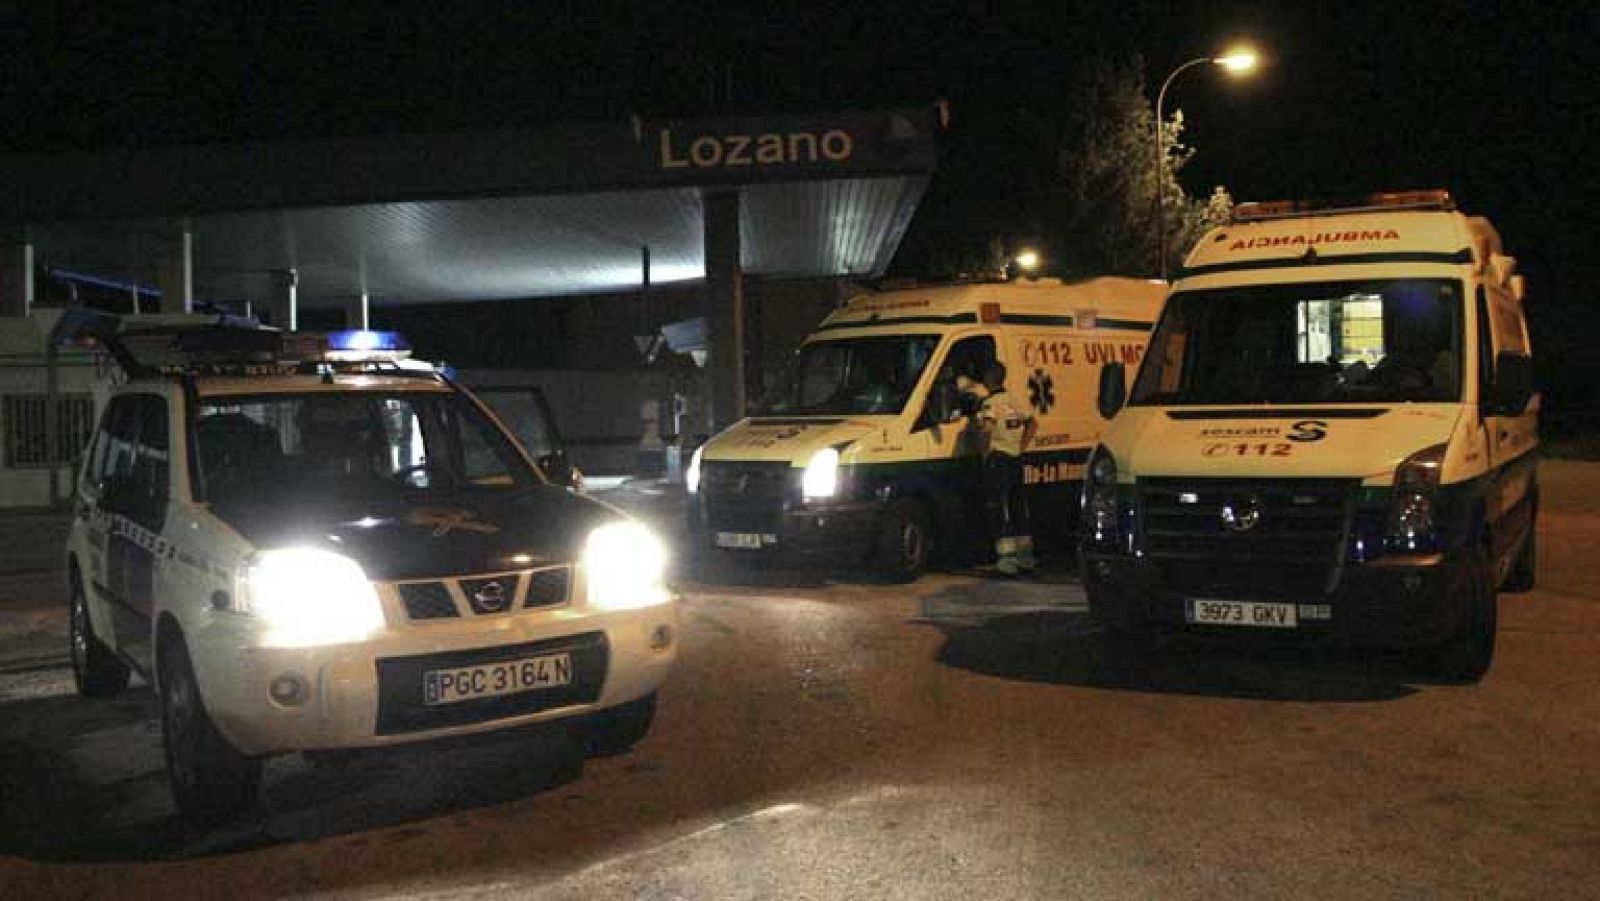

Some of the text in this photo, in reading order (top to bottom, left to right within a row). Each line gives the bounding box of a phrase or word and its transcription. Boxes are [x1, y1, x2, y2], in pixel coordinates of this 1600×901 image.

[660, 128, 854, 168] Lozano
[1038, 341, 1074, 366] 112
[1233, 443, 1293, 457] 112
[1200, 602, 1243, 621] 3973
[1254, 605, 1287, 623] GKV
[440, 655, 568, 699] PGC 3164 N
